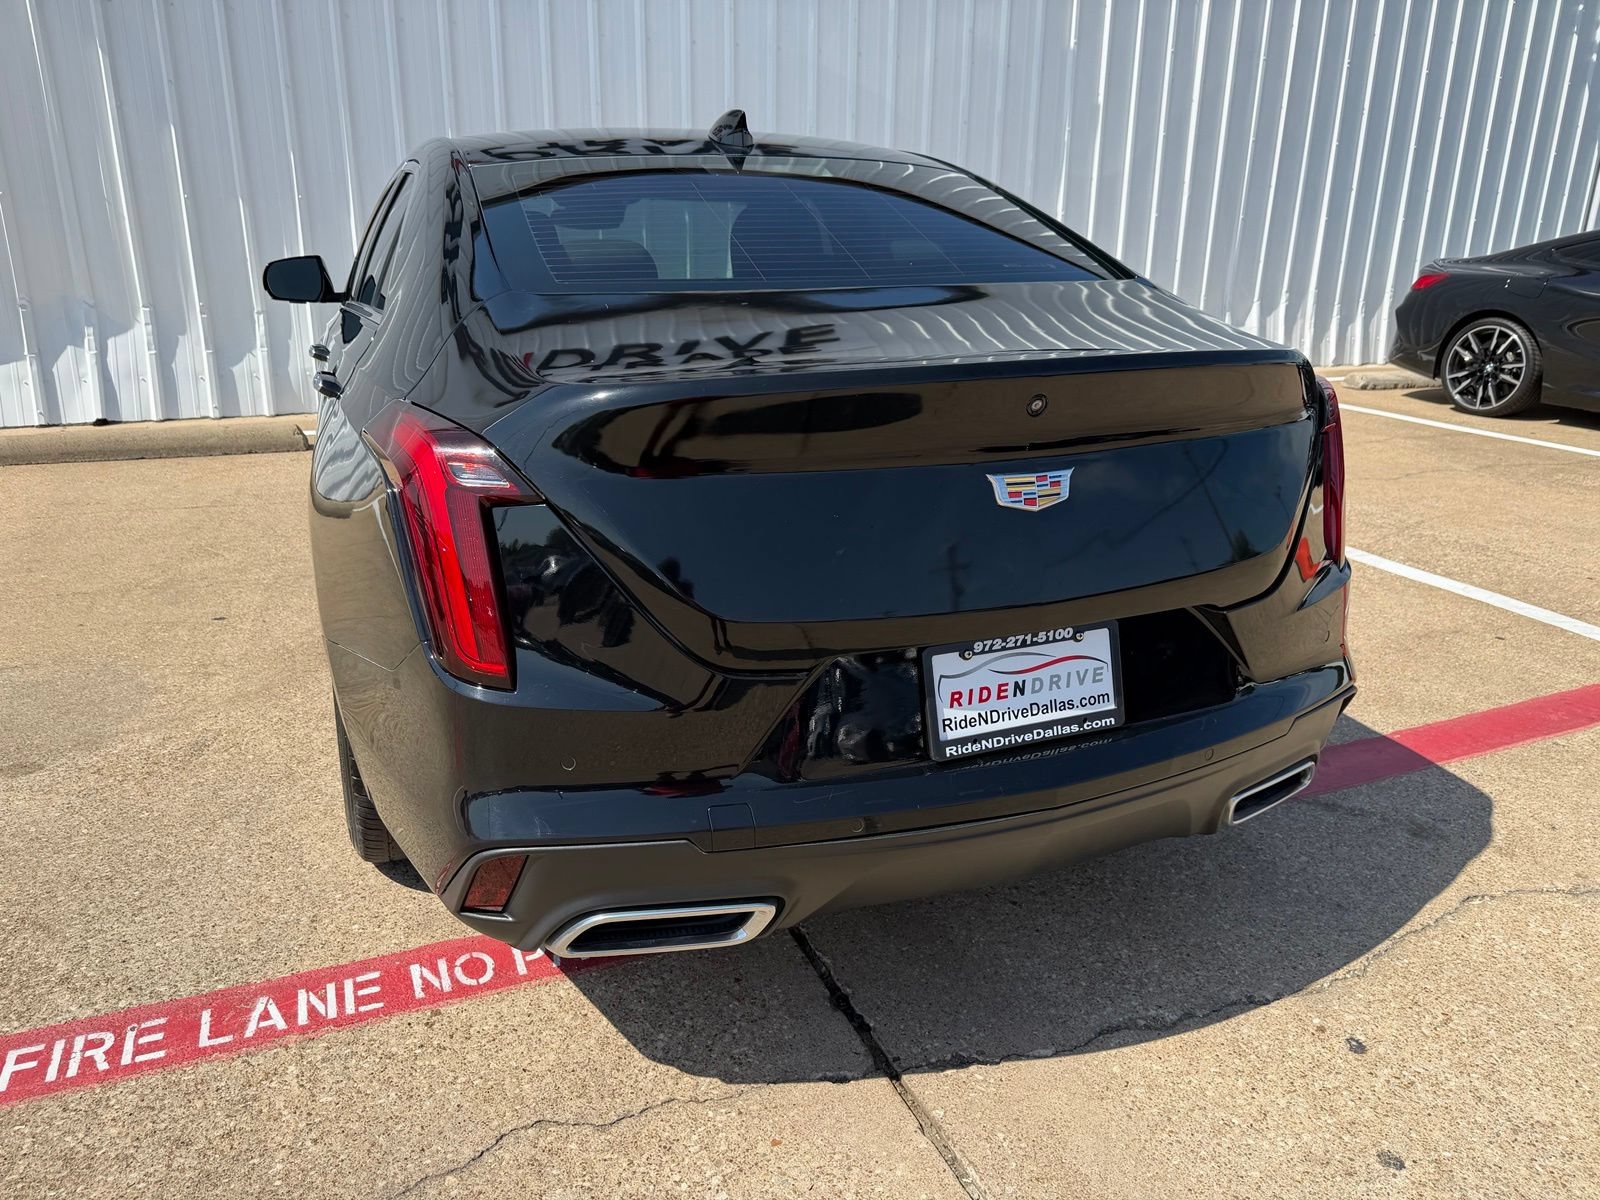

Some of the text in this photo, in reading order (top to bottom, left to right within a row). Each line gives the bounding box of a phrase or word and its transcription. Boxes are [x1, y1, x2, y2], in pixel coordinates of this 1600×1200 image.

[973, 627, 1074, 652] 972-271-5100
[942, 691, 1110, 733] RideNDriveDallas.com
[945, 716, 1116, 757] RideNDriveDallas.com
[0, 950, 495, 1092] FIRE LANE NO
